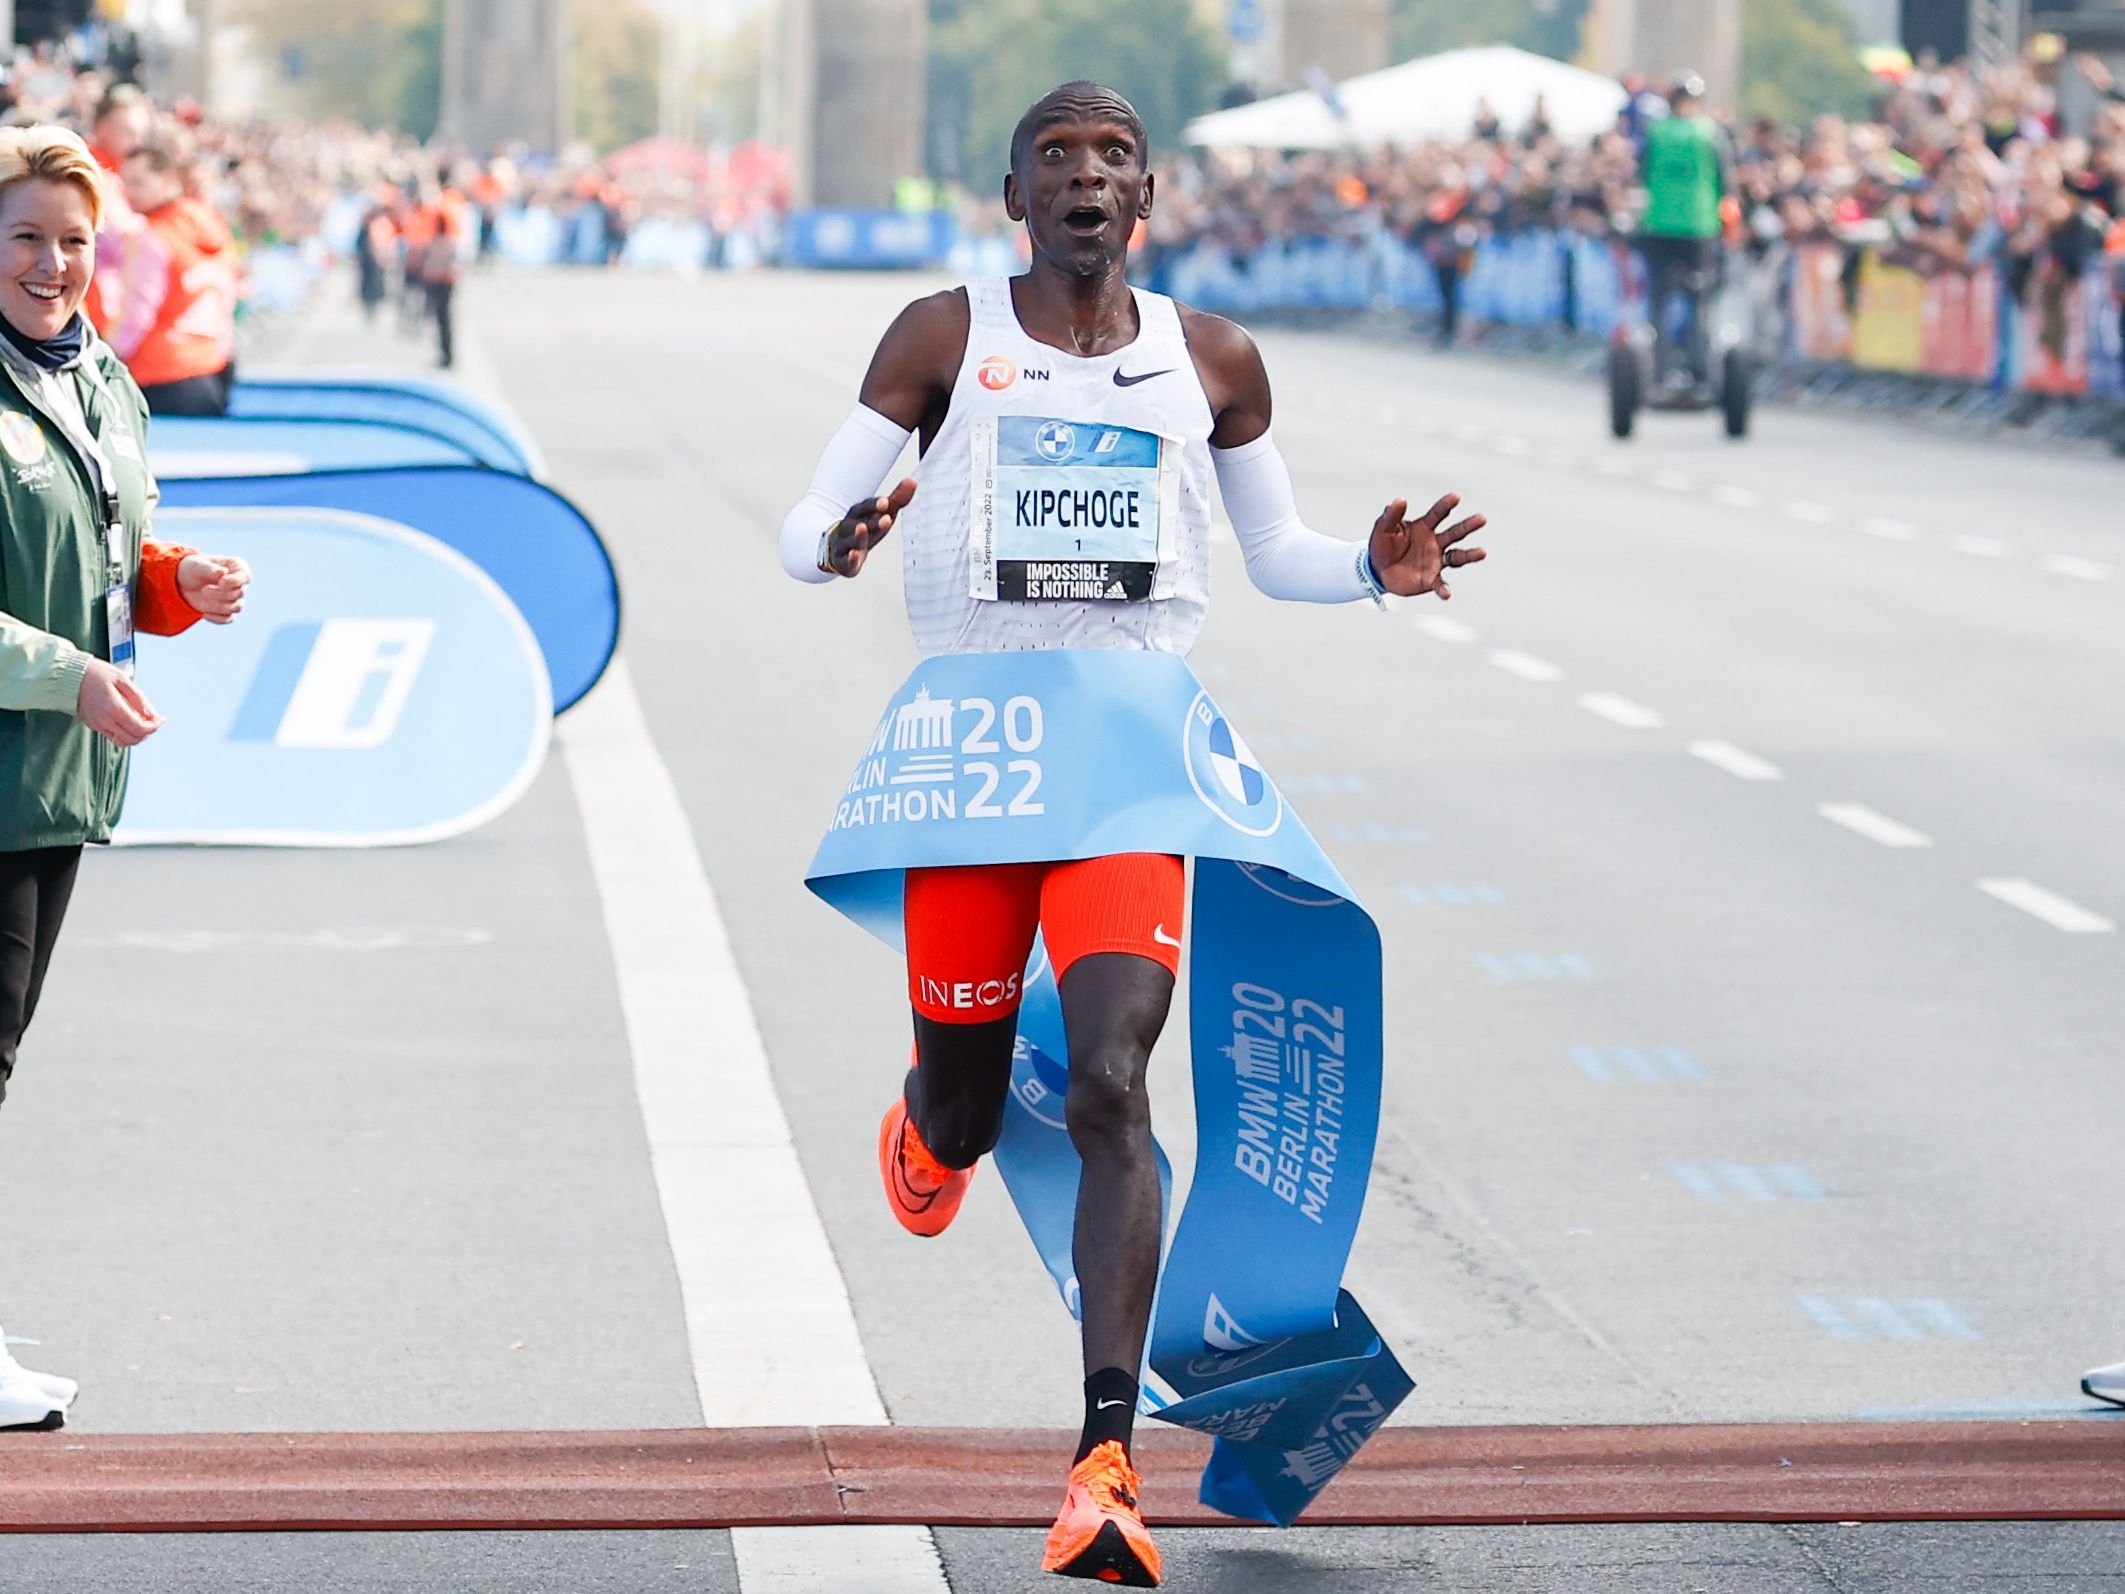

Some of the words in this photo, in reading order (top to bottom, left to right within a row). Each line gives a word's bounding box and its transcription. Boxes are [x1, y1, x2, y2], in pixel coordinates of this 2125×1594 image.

[1023, 368, 1050, 381] NN
[984, 493, 993, 515] 2022
[1015, 489, 1140, 529] KIPCHOGE
[1075, 538, 1082, 551] 1
[1026, 563, 1109, 581] IMPOSSIBLE
[1026, 581, 1040, 598] IS
[1042, 581, 1104, 598] NOTHING
[960, 695, 1044, 754] 20
[826, 788, 957, 832] RATHON
[963, 759, 1046, 818] 22
[919, 971, 1018, 1009] INEOS
[1232, 982, 1286, 1038] 20
[1292, 998, 1345, 1055] 22
[1234, 1079, 1280, 1187] BMW
[1271, 1091, 1311, 1206] BERLIN
[1299, 1053, 1346, 1225] MARATHON
